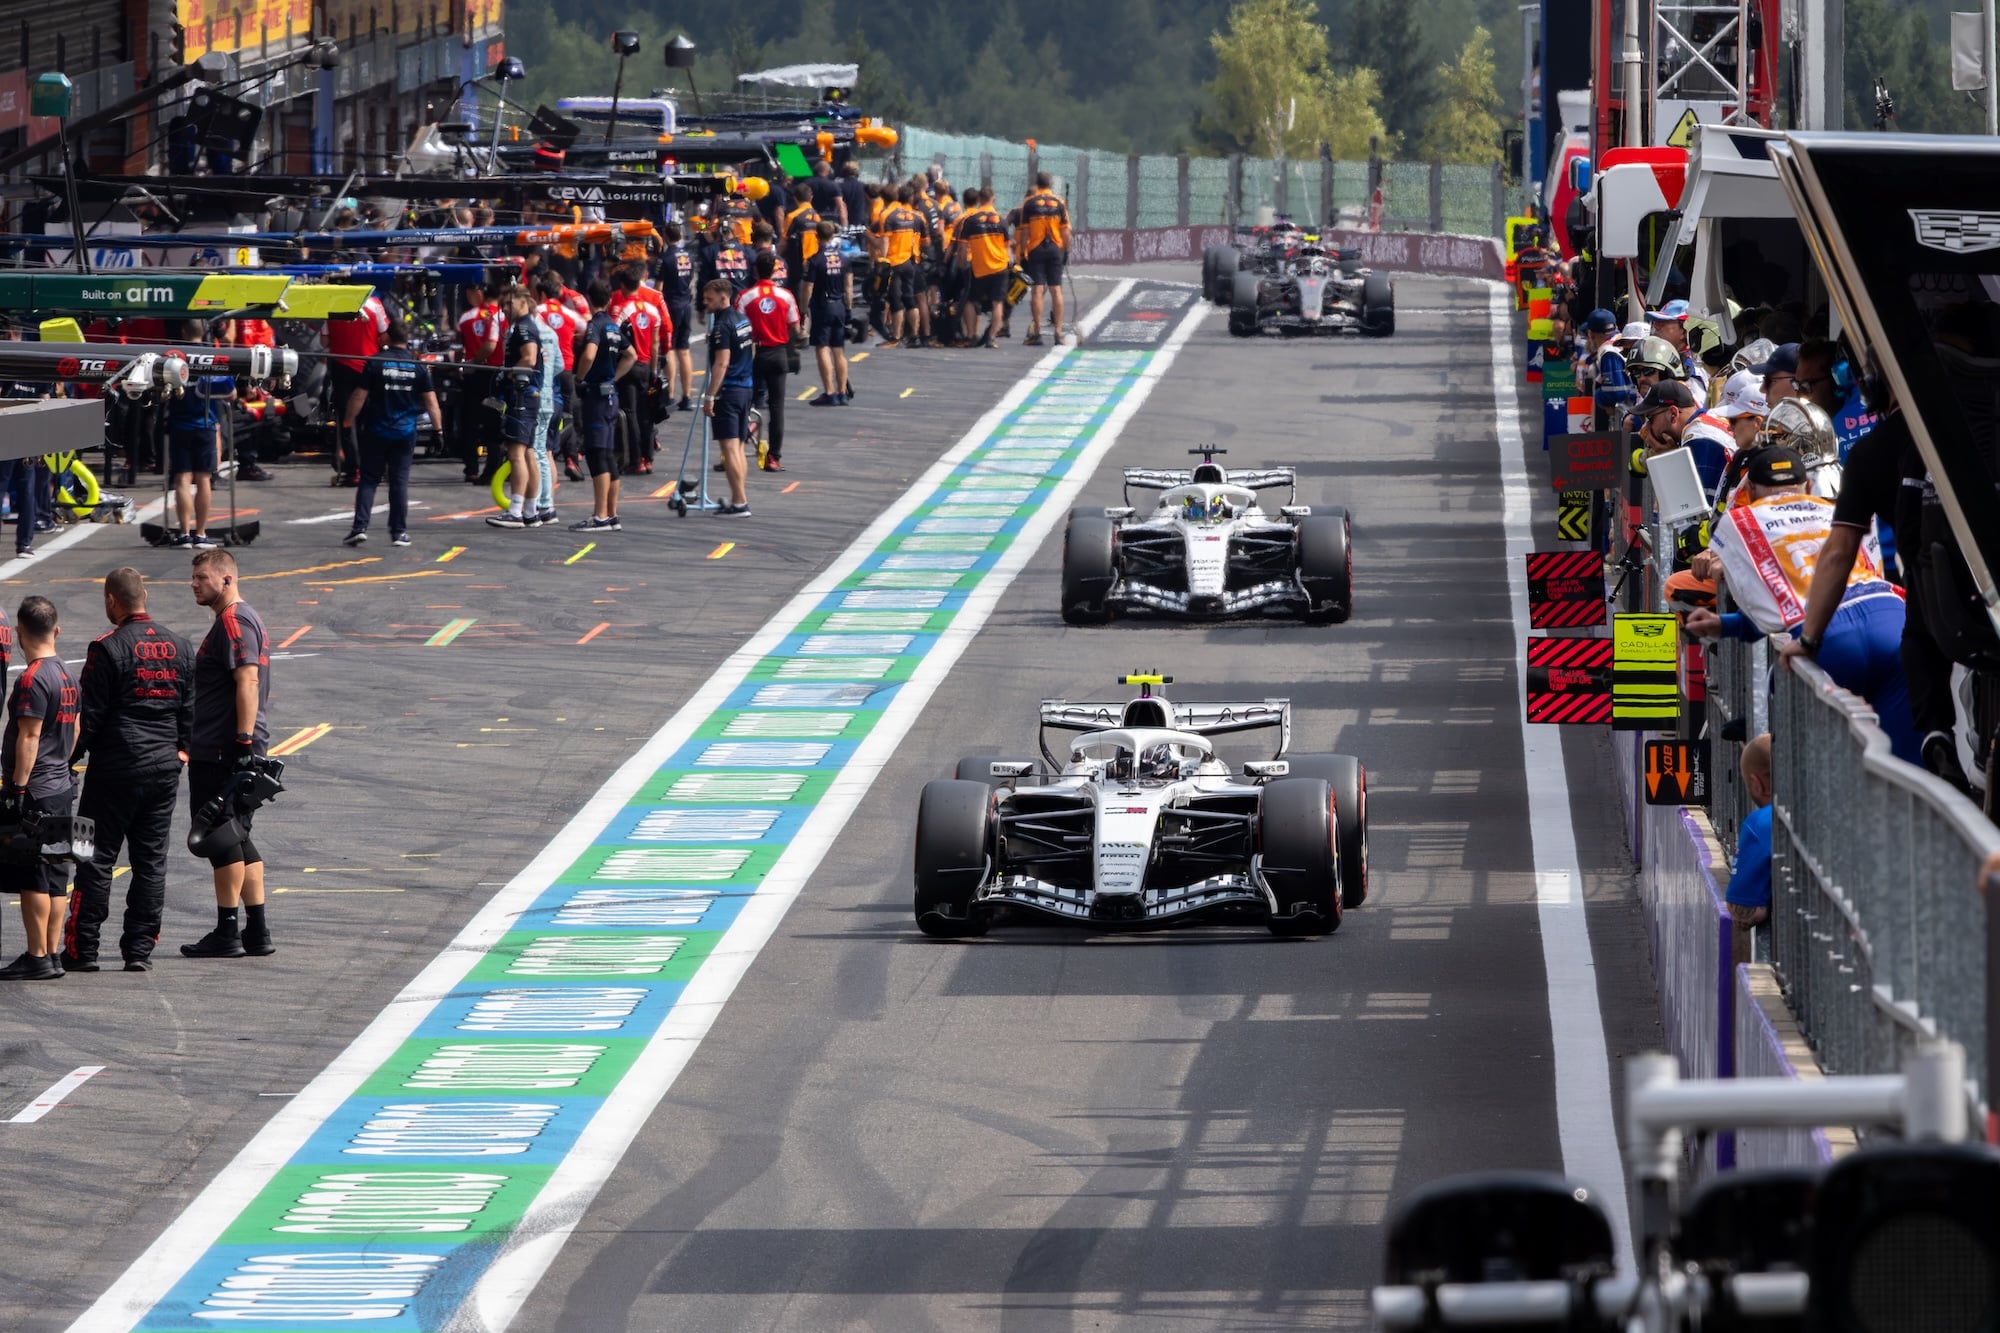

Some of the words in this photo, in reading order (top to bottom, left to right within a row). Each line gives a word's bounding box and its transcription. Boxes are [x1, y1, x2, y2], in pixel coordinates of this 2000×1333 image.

[607, 193, 665, 201] LOGISTICS
[526, 231, 560, 244] Gulf
[82, 289, 106, 300] Built
[107, 292, 122, 300] on
[126, 285, 174, 302] arm
[80, 359, 120, 371] TGR
[188, 354, 231, 365] TGR
[1765, 519, 1786, 531] PIT
[1759, 557, 1801, 622] BELGIUM
[1621, 641, 1676, 649] CADILLAC
[136, 667, 177, 681] Revolut
[1663, 744, 1674, 777] BOX
